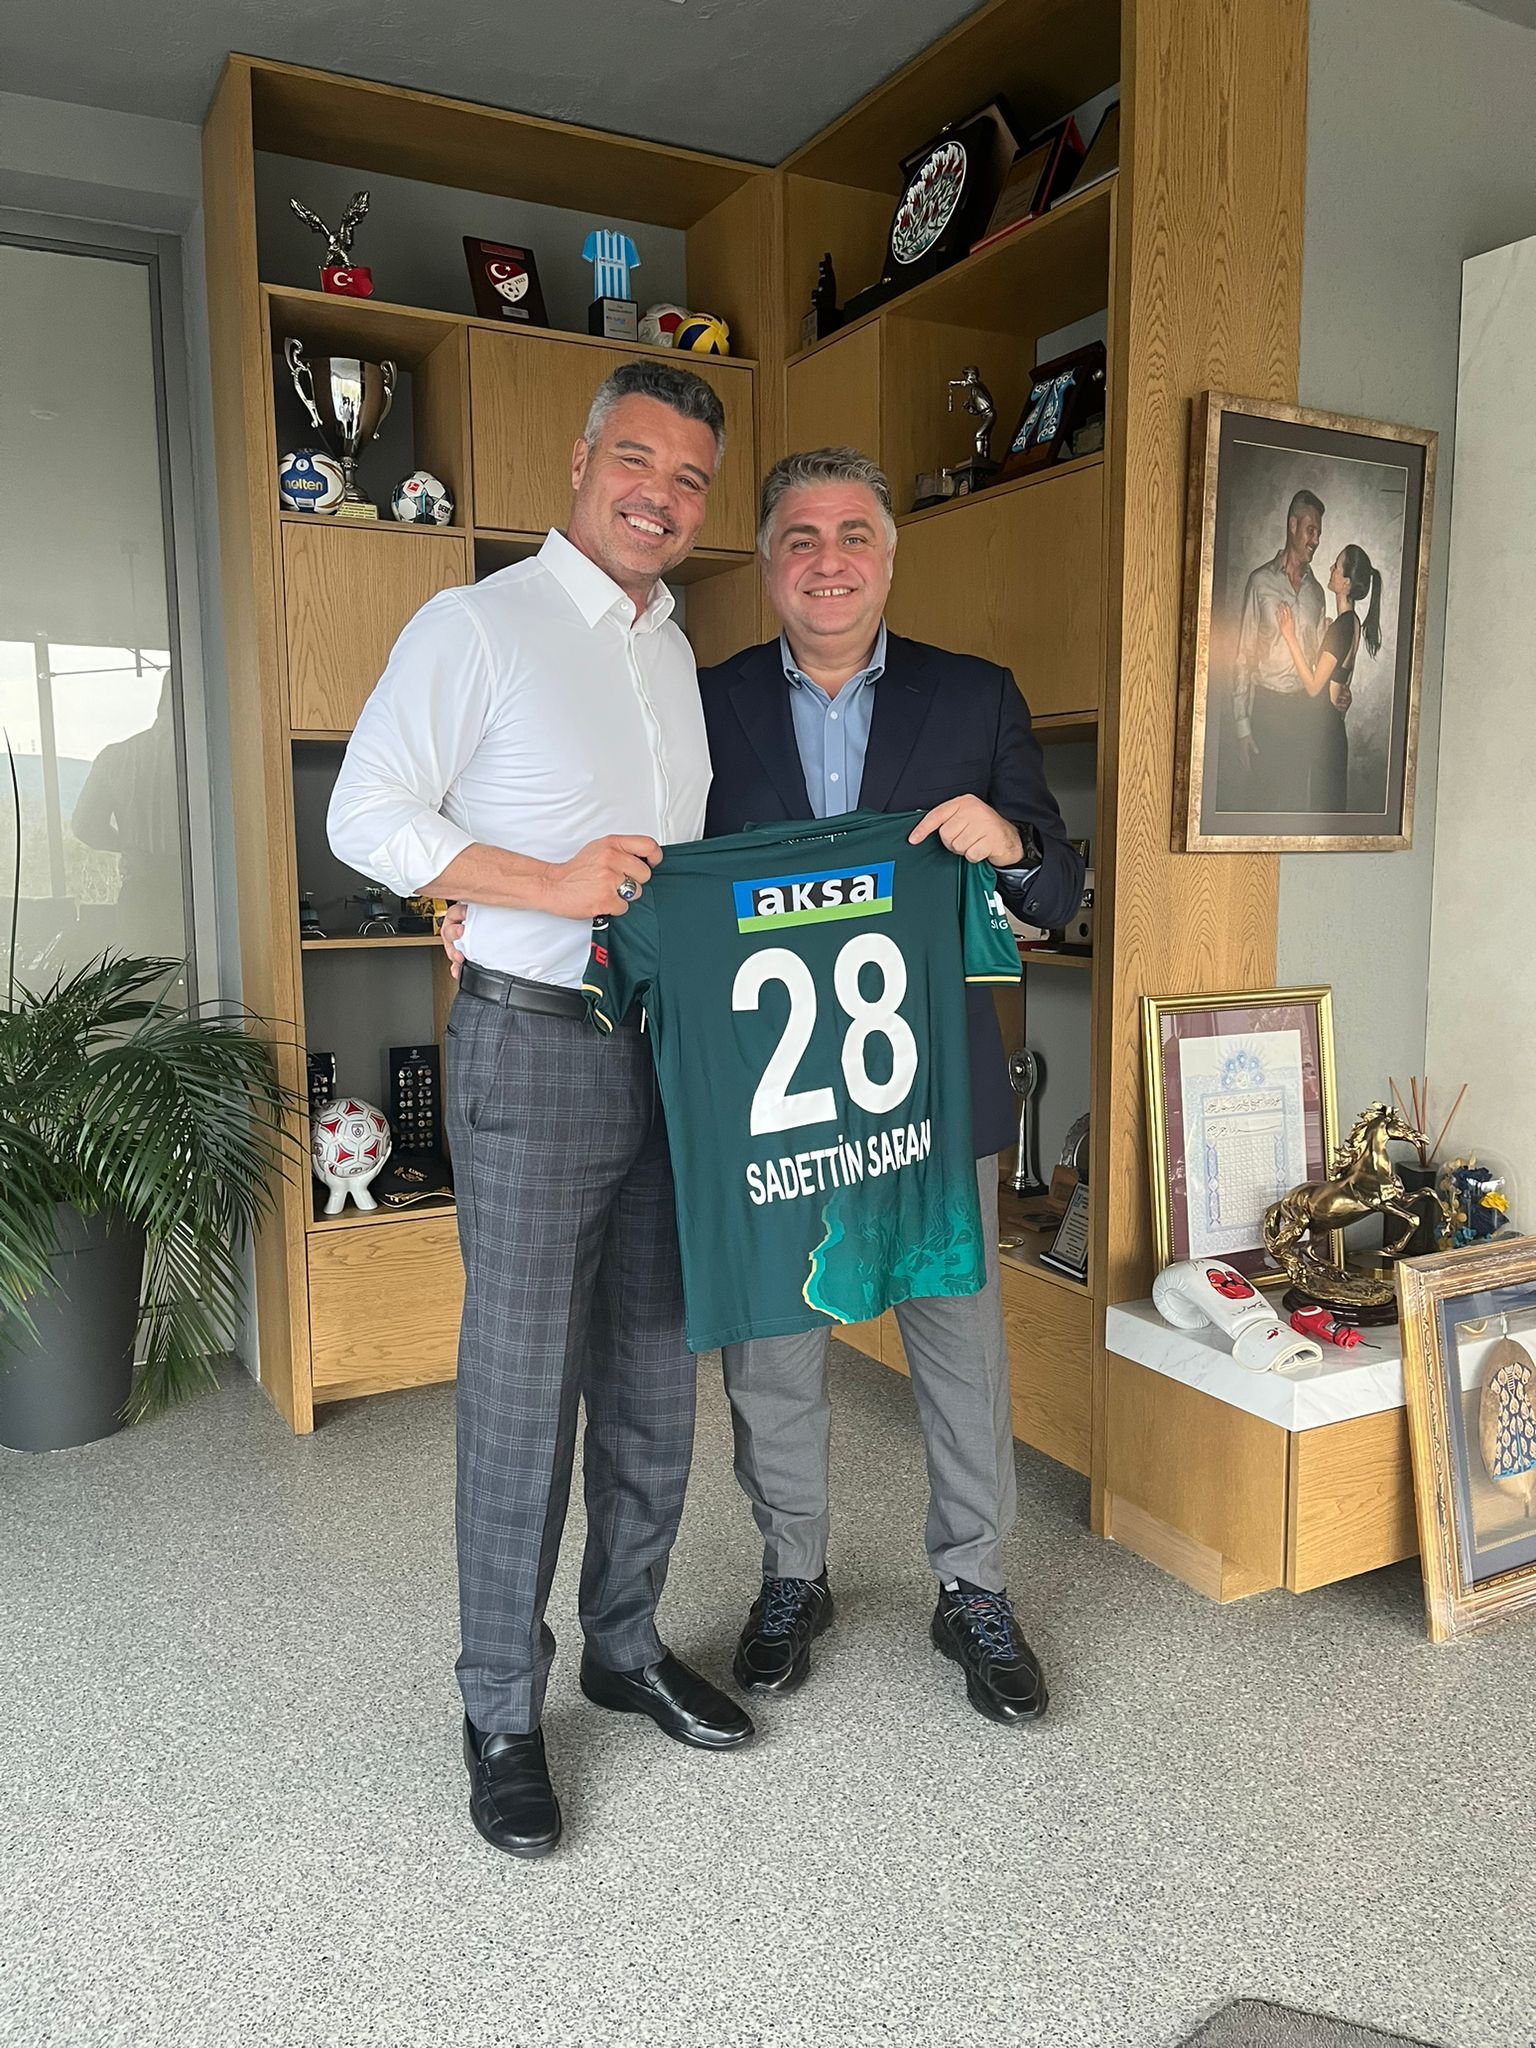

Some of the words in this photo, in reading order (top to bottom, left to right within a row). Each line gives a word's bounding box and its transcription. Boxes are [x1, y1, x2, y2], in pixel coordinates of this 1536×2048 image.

[757, 874, 875, 917] aksa
[732, 932, 918, 1136] 28
[746, 1134, 864, 1205] SADETTİN
[867, 1118, 931, 1177] SARAN
